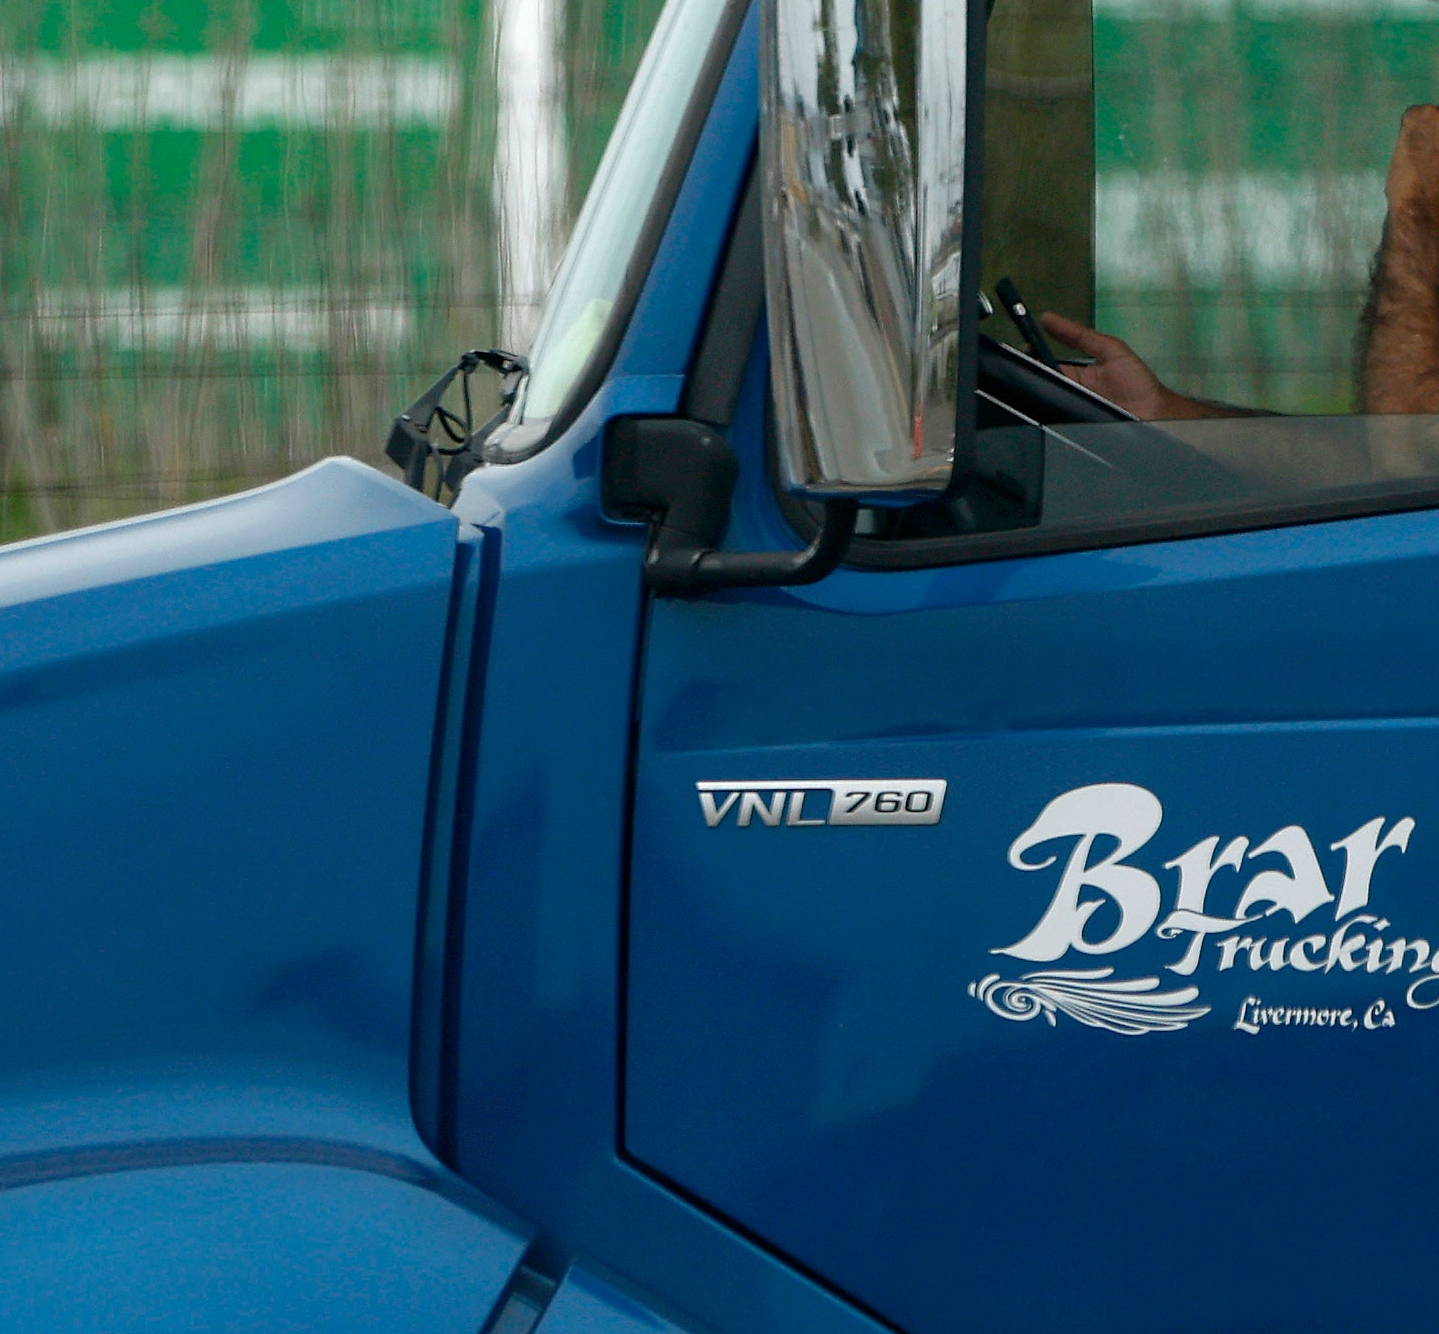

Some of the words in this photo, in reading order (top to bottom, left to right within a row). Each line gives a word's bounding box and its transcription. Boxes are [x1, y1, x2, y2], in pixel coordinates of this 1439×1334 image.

[699, 791, 826, 827] VNL
[845, 791, 934, 814] 760
[989, 782, 1416, 962] Brar
[1233, 995, 1359, 1035] Livermore,
[1363, 997, 1397, 1030] Ca
